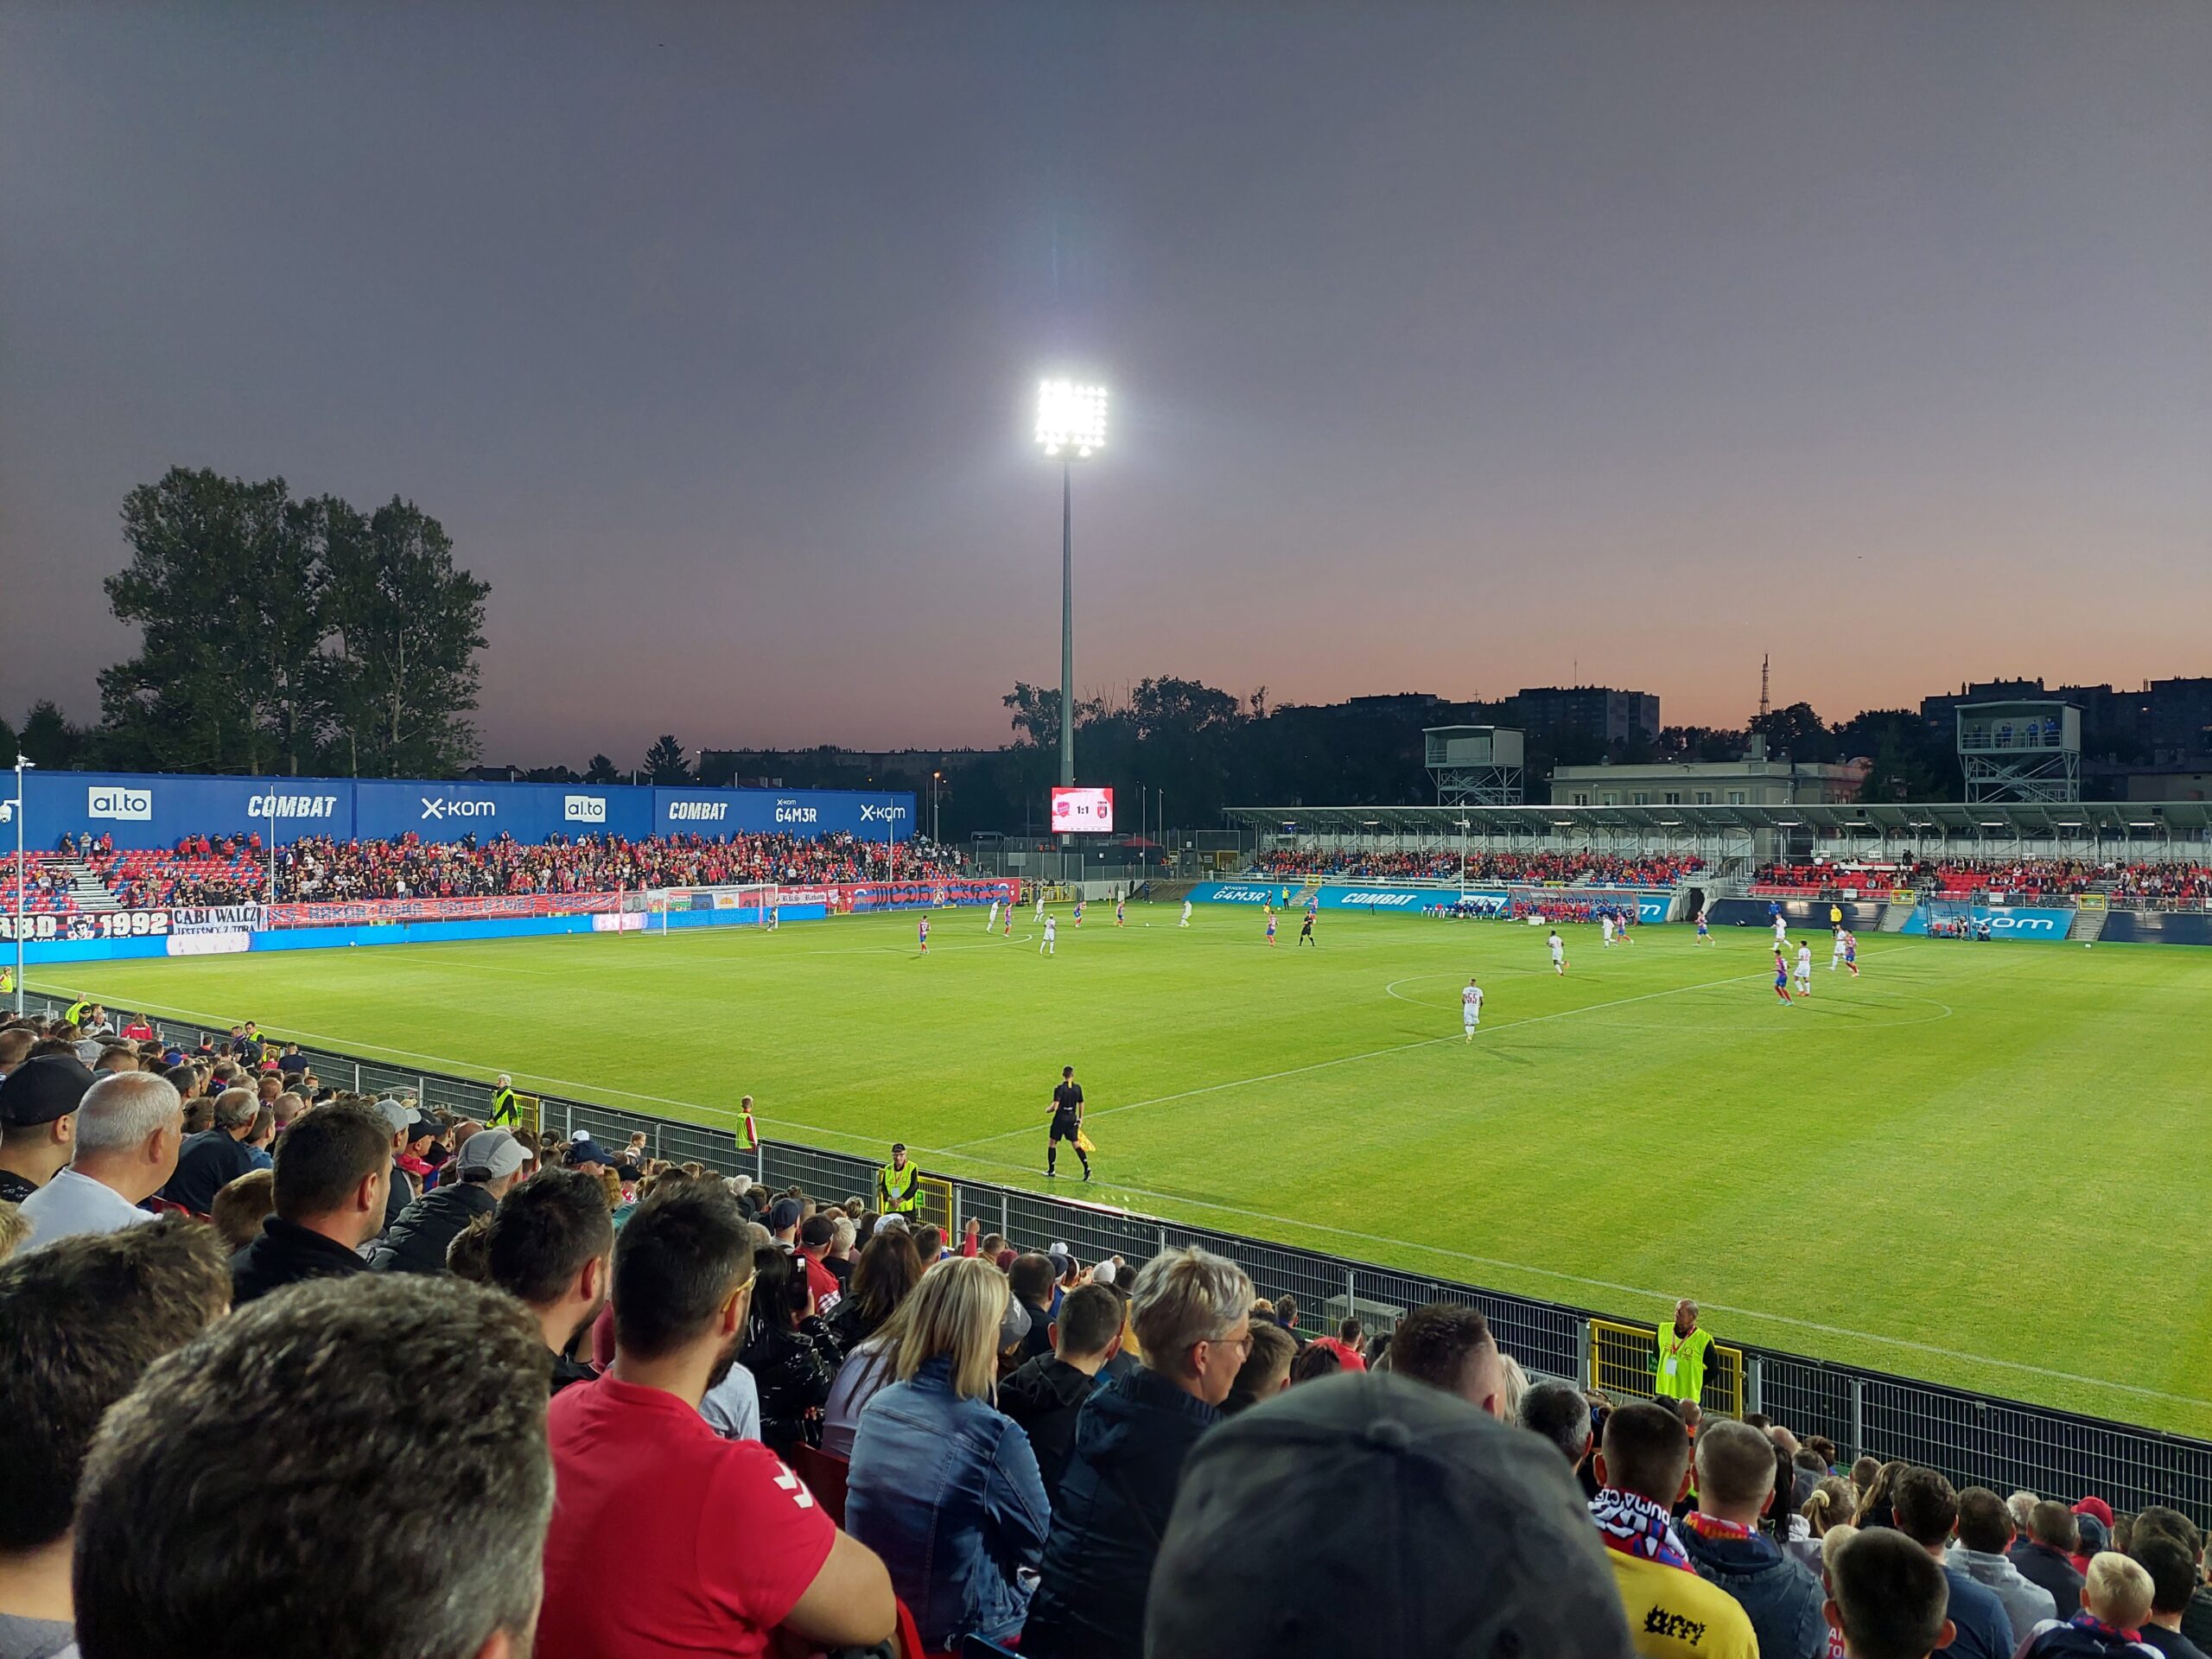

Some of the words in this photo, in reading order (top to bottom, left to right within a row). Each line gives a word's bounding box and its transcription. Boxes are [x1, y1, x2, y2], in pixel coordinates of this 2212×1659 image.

[93, 793, 147, 811] al.to
[247, 795, 337, 817] COMBAT
[568, 800, 603, 816] al.to
[1077, 805, 1089, 814] 1:1
[669, 802, 728, 820] COMBAT
[775, 808, 817, 823] G4M3R
[1213, 891, 1265, 901] G4M3R
[1341, 893, 1417, 906] COMBAT
[99, 912, 168, 936] 1992
[1467, 993, 1478, 1004] 55
